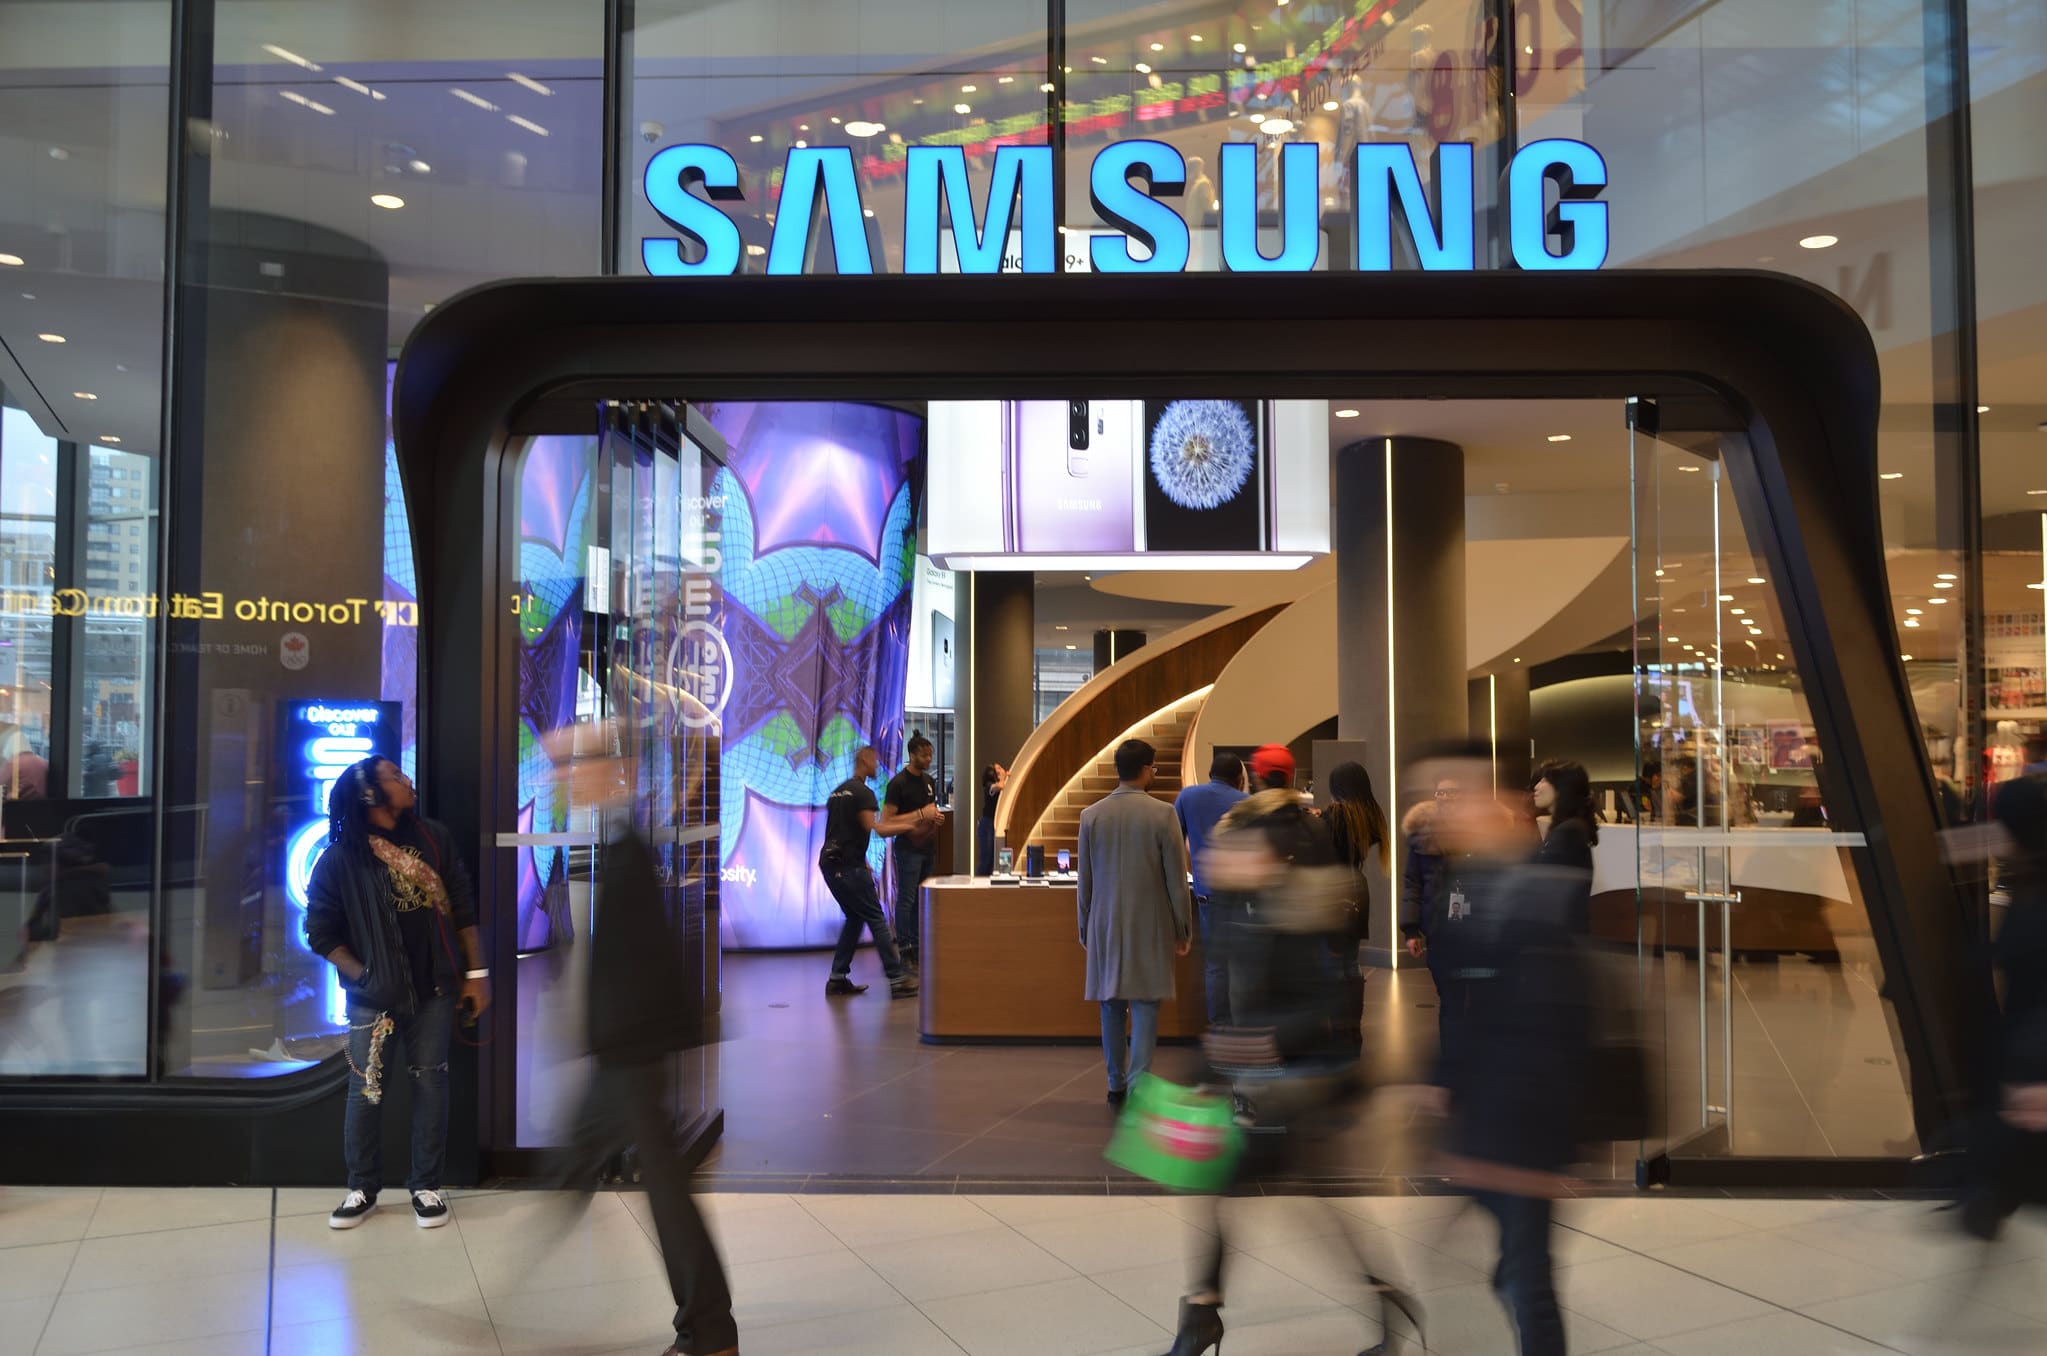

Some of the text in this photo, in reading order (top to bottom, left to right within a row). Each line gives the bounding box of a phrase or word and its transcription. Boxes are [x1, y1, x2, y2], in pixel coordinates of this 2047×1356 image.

[641, 138, 1611, 276] SAMSUNG
[307, 705, 379, 722] Discover
[720, 864, 757, 888] osity.
